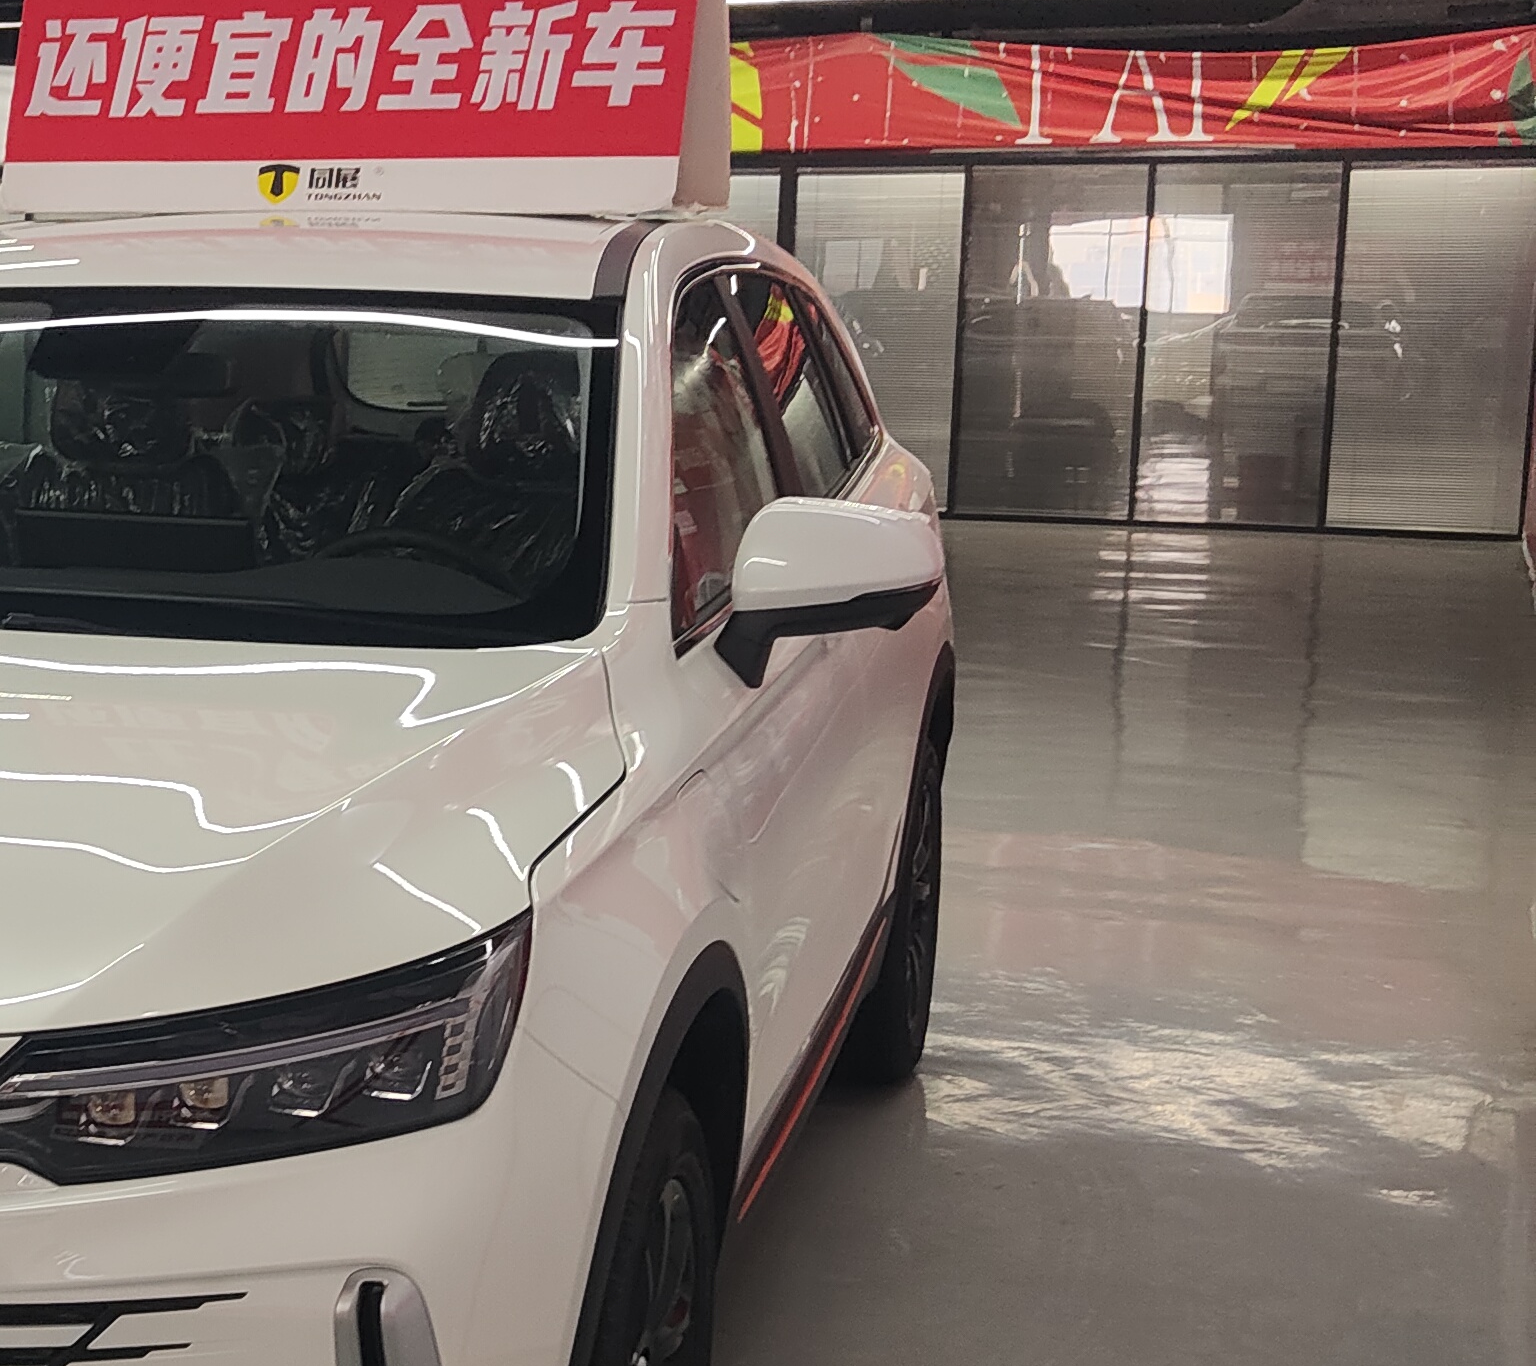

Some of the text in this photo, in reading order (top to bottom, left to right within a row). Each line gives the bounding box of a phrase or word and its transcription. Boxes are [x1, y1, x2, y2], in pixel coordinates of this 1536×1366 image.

[24, 0, 677, 120] 还便宜的全新车
[305, 192, 382, 202] TONGZHAN
